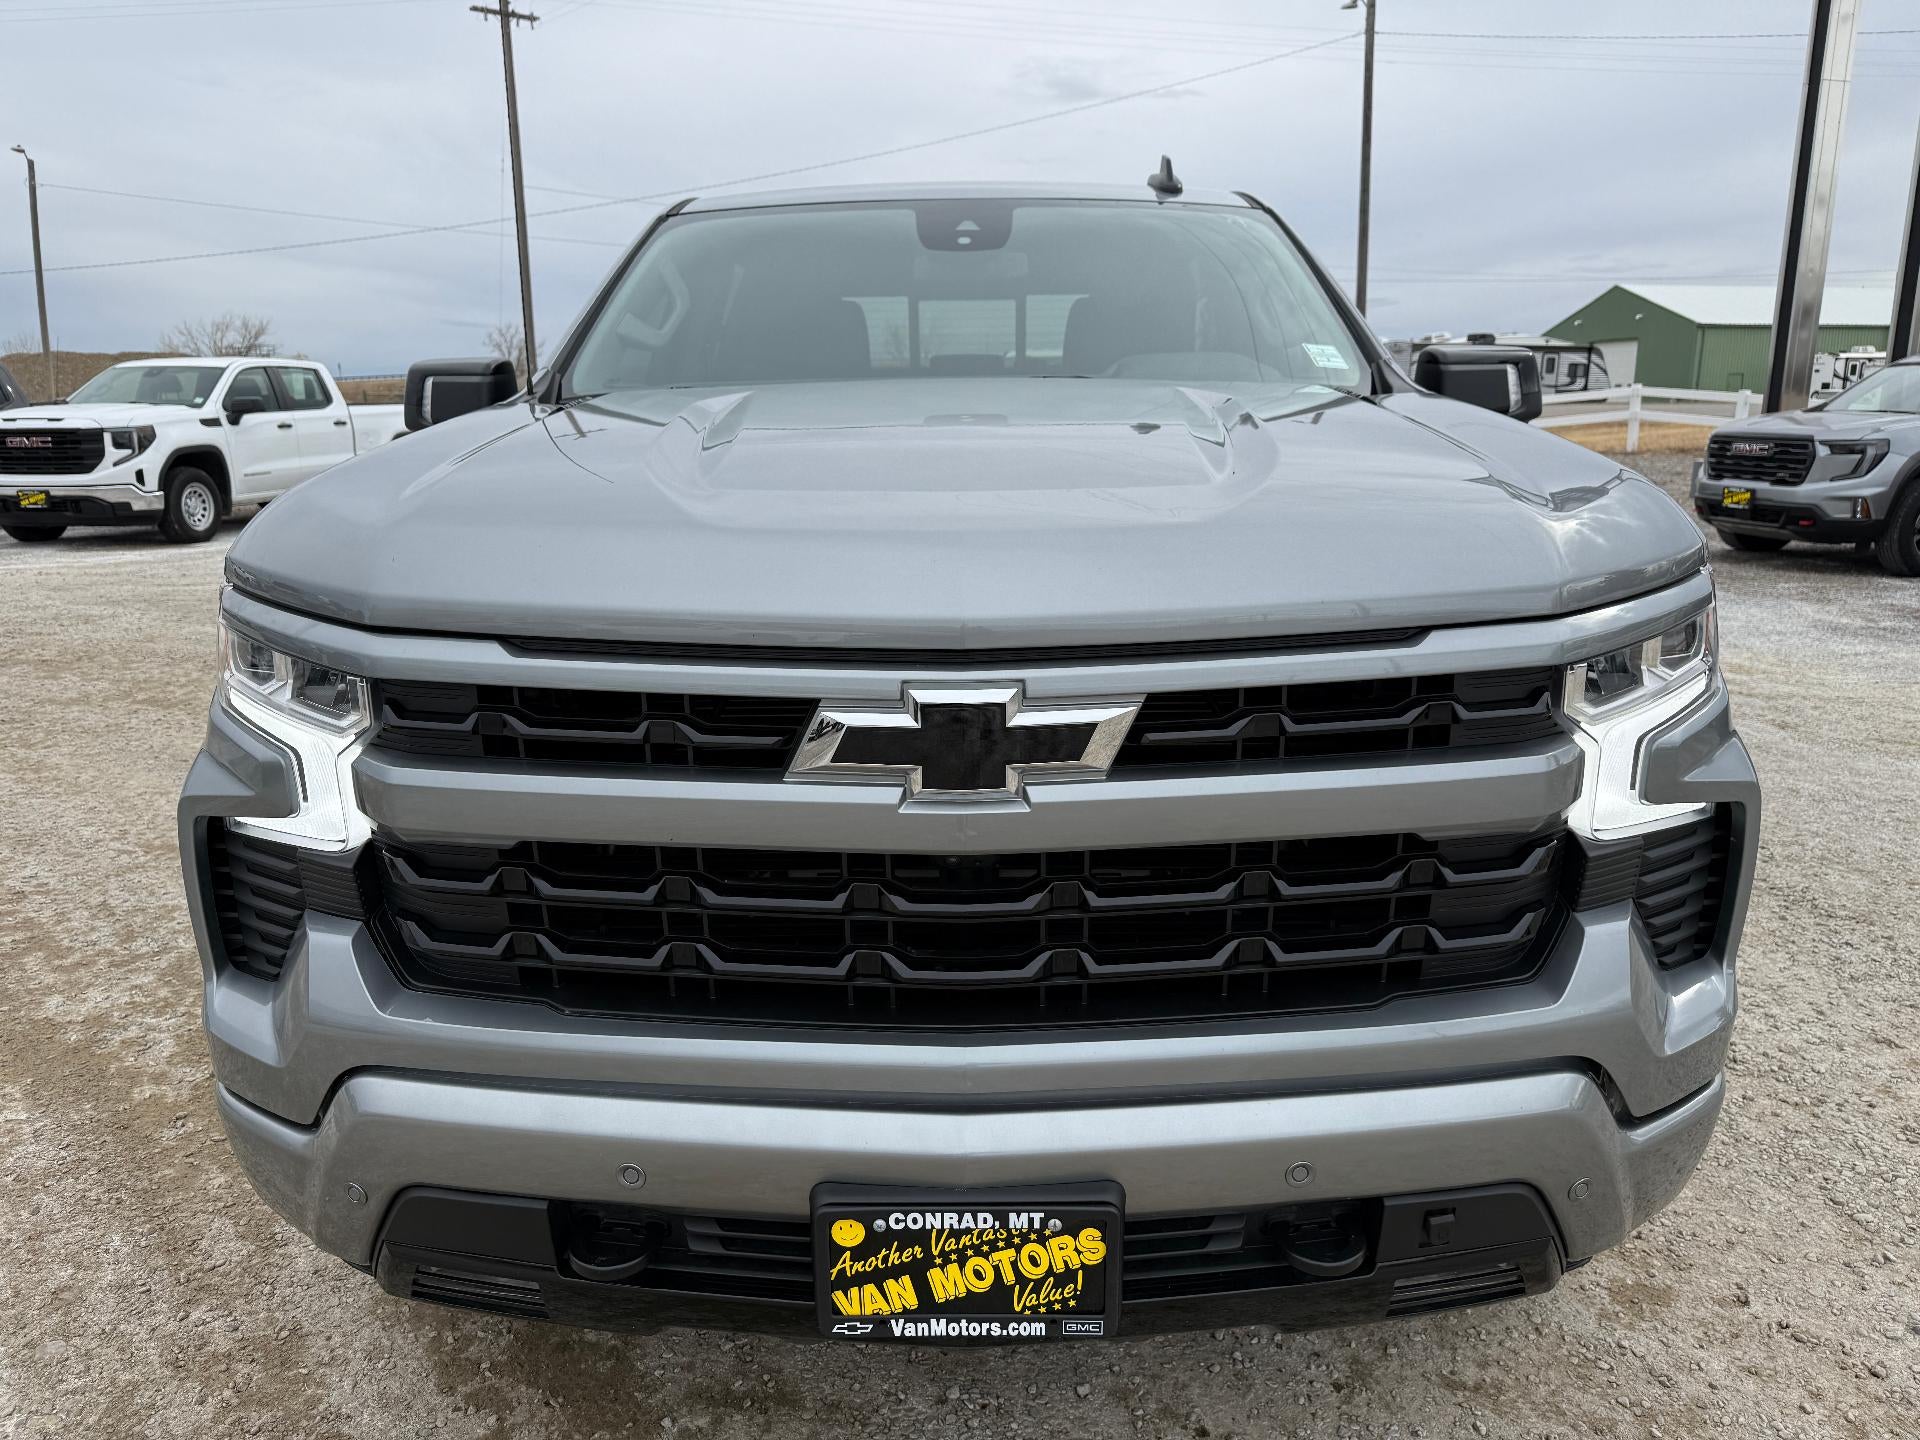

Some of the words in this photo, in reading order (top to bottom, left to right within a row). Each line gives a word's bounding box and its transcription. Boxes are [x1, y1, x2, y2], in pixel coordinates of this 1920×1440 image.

[6, 436, 52, 448] GMC
[1732, 442, 1769, 456] GMC
[888, 1212, 1000, 1230] CONRAD,
[1008, 1212, 1045, 1229] MT
[830, 1241, 924, 1281] Another
[831, 1274, 919, 1316] VAN
[926, 1227, 1107, 1304] MOTORS
[1013, 1269, 1083, 1312] Value!
[890, 1318, 1046, 1337] VanMotors.com
[1065, 1323, 1101, 1333] GMC
